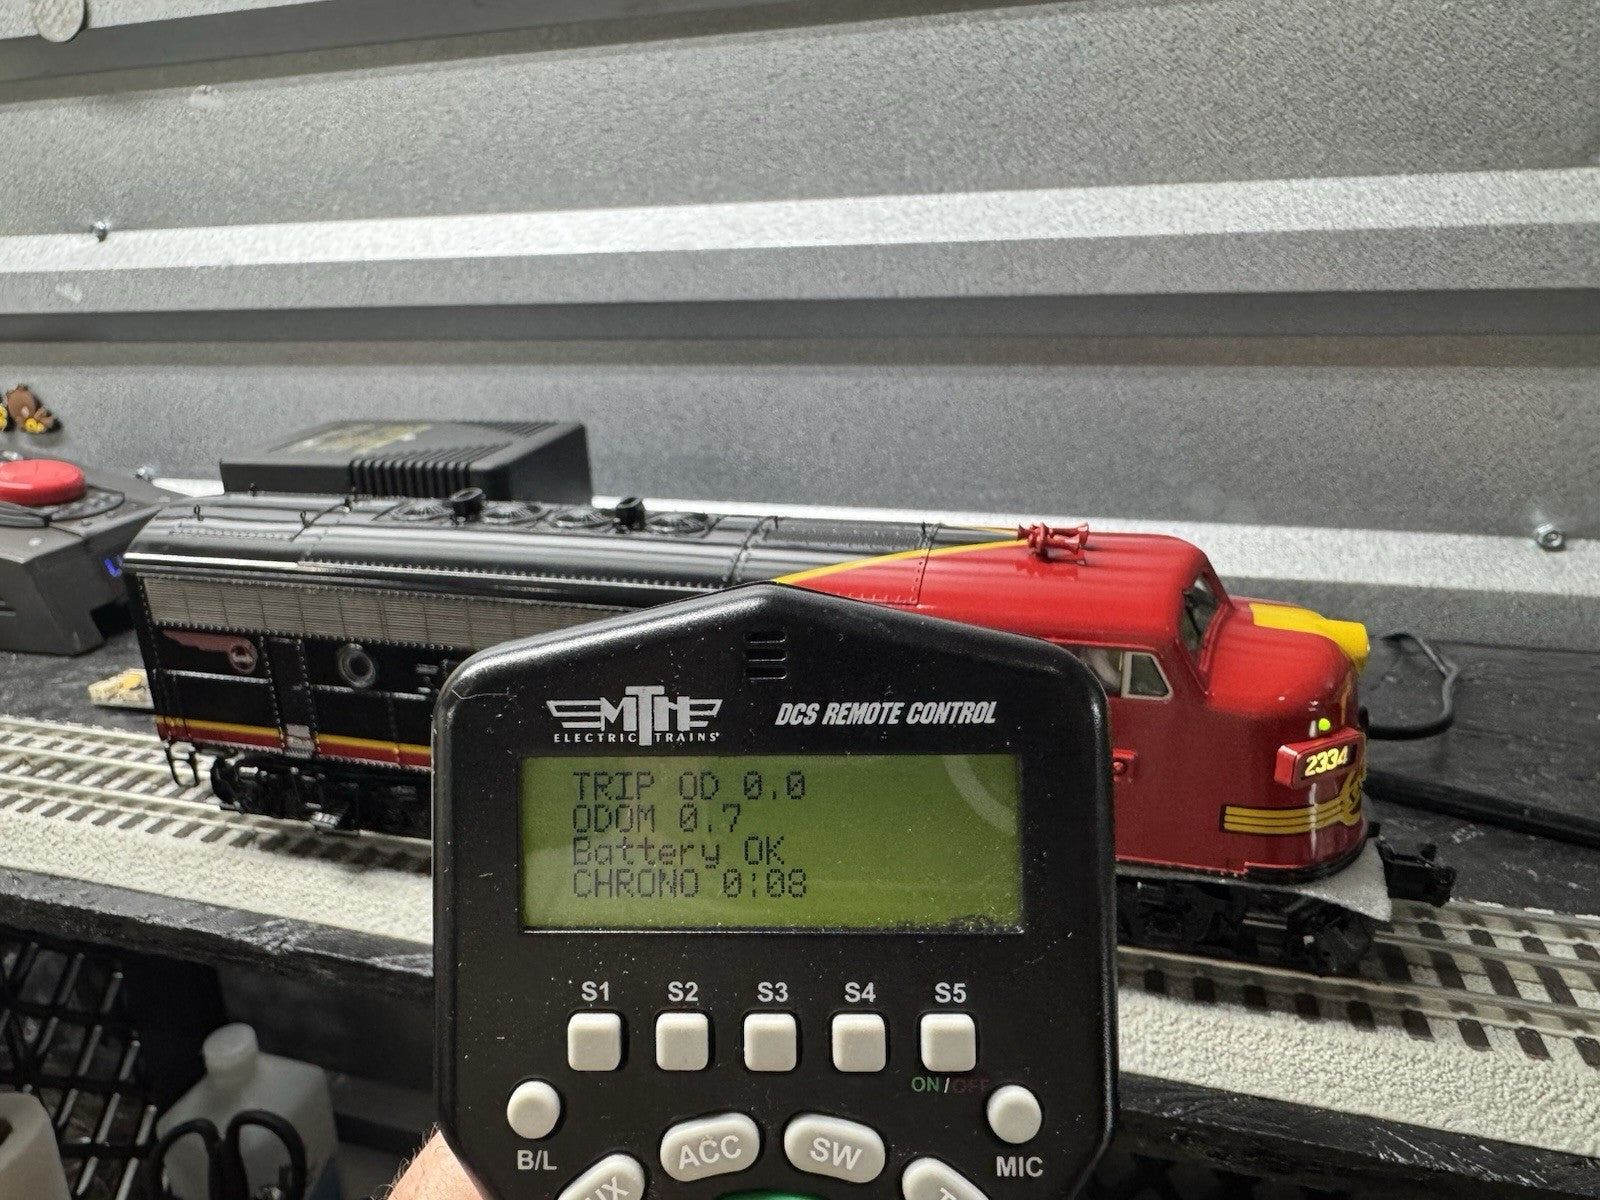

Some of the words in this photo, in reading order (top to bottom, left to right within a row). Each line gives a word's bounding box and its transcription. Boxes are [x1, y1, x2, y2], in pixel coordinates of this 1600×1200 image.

[600, 686, 690, 746] MTH
[775, 703, 820, 725] DCS
[821, 702, 905, 725] REMOTE
[906, 701, 997, 725] CONTROL
[553, 733, 637, 743] ELECTRIC
[655, 733, 718, 742] TRAINS
[1304, 745, 1349, 777] 2334
[573, 771, 655, 800] TRIP
[679, 771, 719, 800] OD
[743, 771, 805, 800] 0.0
[573, 804, 655, 833] ODOM
[679, 803, 741, 833] 0.7
[573, 836, 719, 869] Battery
[744, 836, 785, 865] OK
[573, 868, 699, 898] CHRONO
[723, 868, 806, 898] 0:08
[581, 981, 610, 1001] S1
[668, 981, 698, 1001] S2
[757, 981, 789, 1002] S3
[844, 981, 876, 1003] S4
[934, 982, 967, 1003] S5
[517, 1150, 557, 1171] B/L
[678, 1135, 742, 1170] ACC
[810, 1137, 863, 1171] SW
[996, 1156, 1044, 1178] MIC
